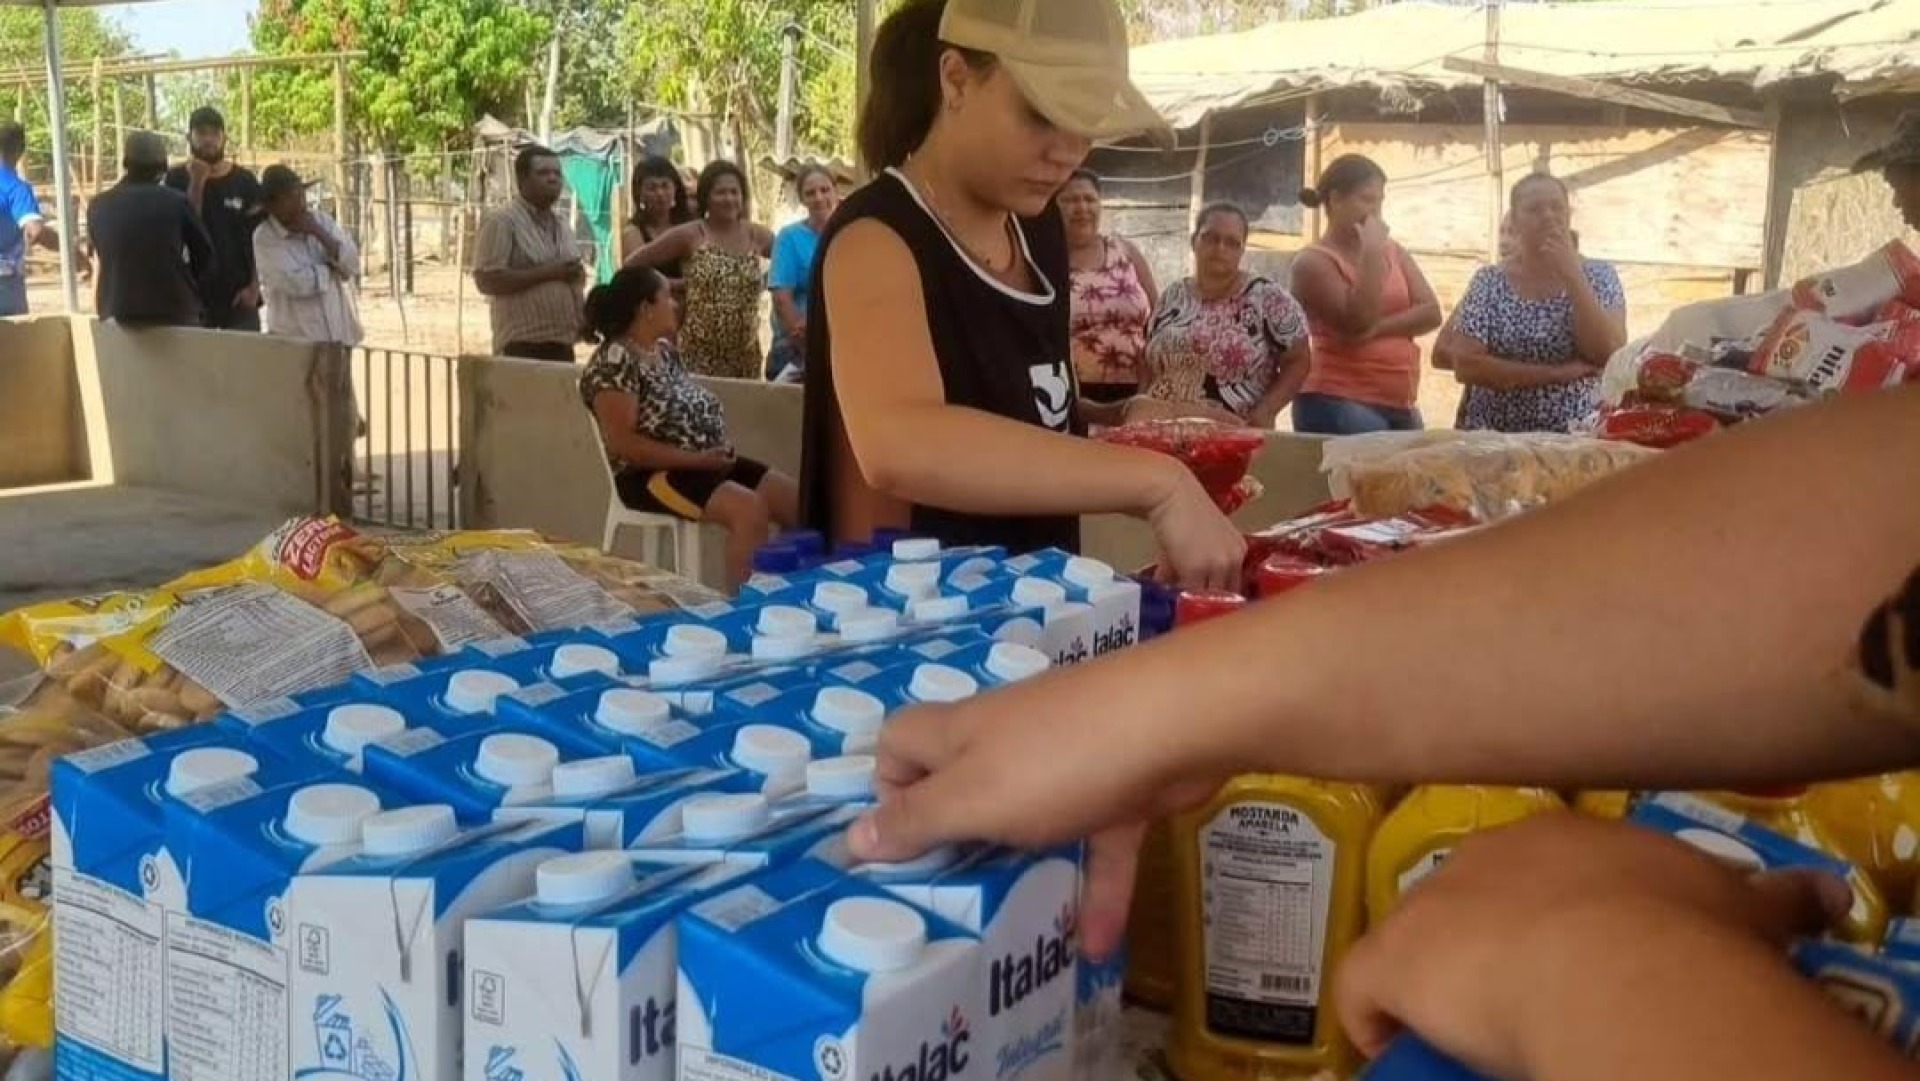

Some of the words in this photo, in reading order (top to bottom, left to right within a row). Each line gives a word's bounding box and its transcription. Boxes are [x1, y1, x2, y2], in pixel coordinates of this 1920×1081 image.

[1229, 806, 1299, 826] MOSTARDA
[989, 934, 1074, 1017] Italac
[629, 995, 677, 1067] Ita
